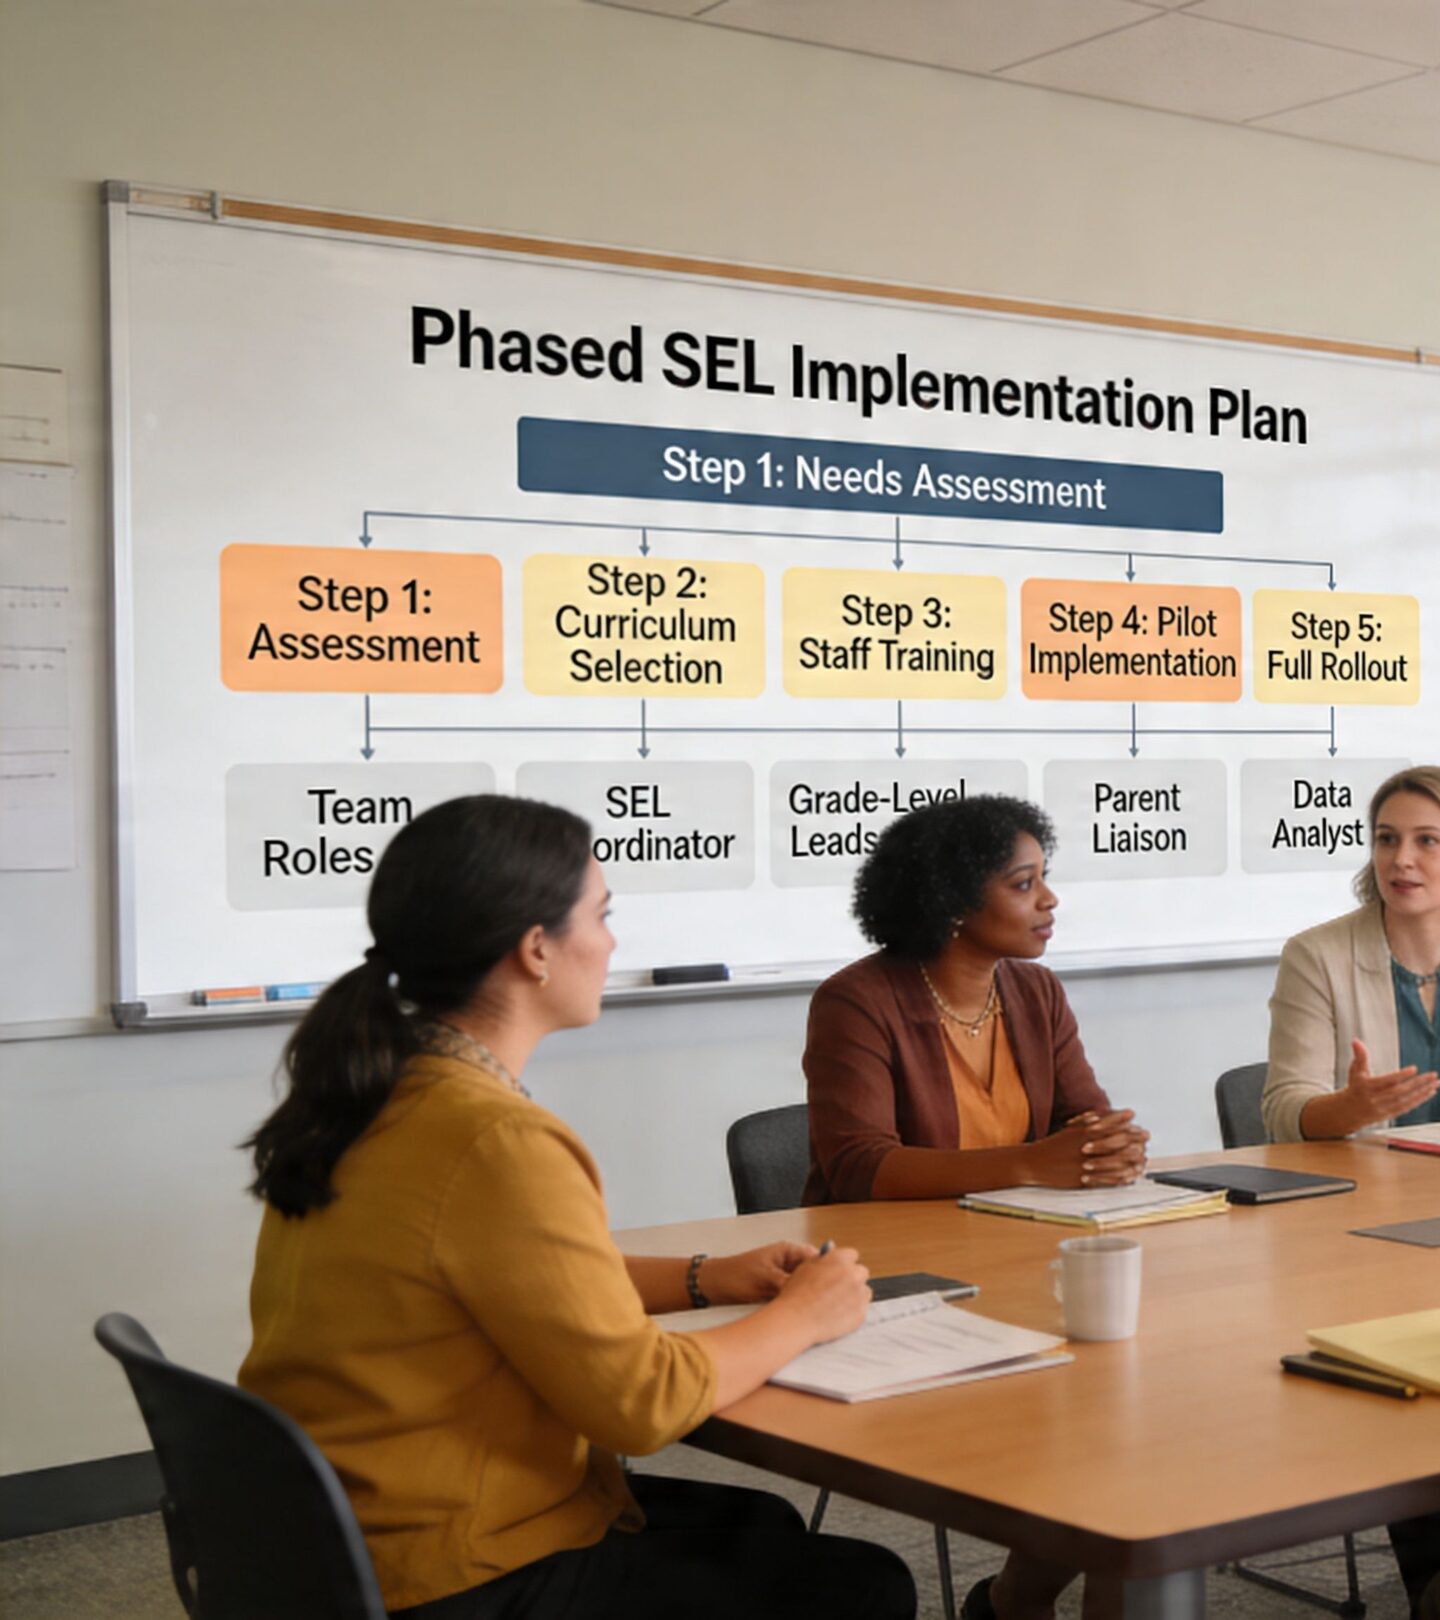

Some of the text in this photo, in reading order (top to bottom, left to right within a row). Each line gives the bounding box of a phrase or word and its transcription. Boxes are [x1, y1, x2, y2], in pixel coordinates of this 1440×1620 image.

[411, 305, 1307, 445] Phased SEL Implementation Plan
[663, 446, 1107, 510] Step 1: Needs Assessment
[298, 575, 431, 623] Step 1:
[588, 562, 707, 607] Step 2:
[555, 602, 736, 642] Curriculum
[842, 594, 951, 635] Step 3:
[1049, 602, 1217, 642] Step 4: Pilot
[1291, 611, 1382, 649] Step 5:
[247, 622, 481, 664] Assessment
[799, 636, 994, 681] Staff Training
[1030, 642, 1236, 682] Implementation
[570, 648, 722, 685] Selection
[1268, 649, 1408, 682] Full Rollout
[307, 788, 413, 825] Team
[606, 784, 671, 819] SEL
[1095, 783, 1181, 813] Parent
[1294, 779, 1352, 809] Data
[593, 827, 736, 862] ordinator
[791, 821, 878, 857] Leads
[1093, 822, 1187, 854] Liaison
[1271, 817, 1364, 855] Analyst
[264, 836, 374, 877] Roles
